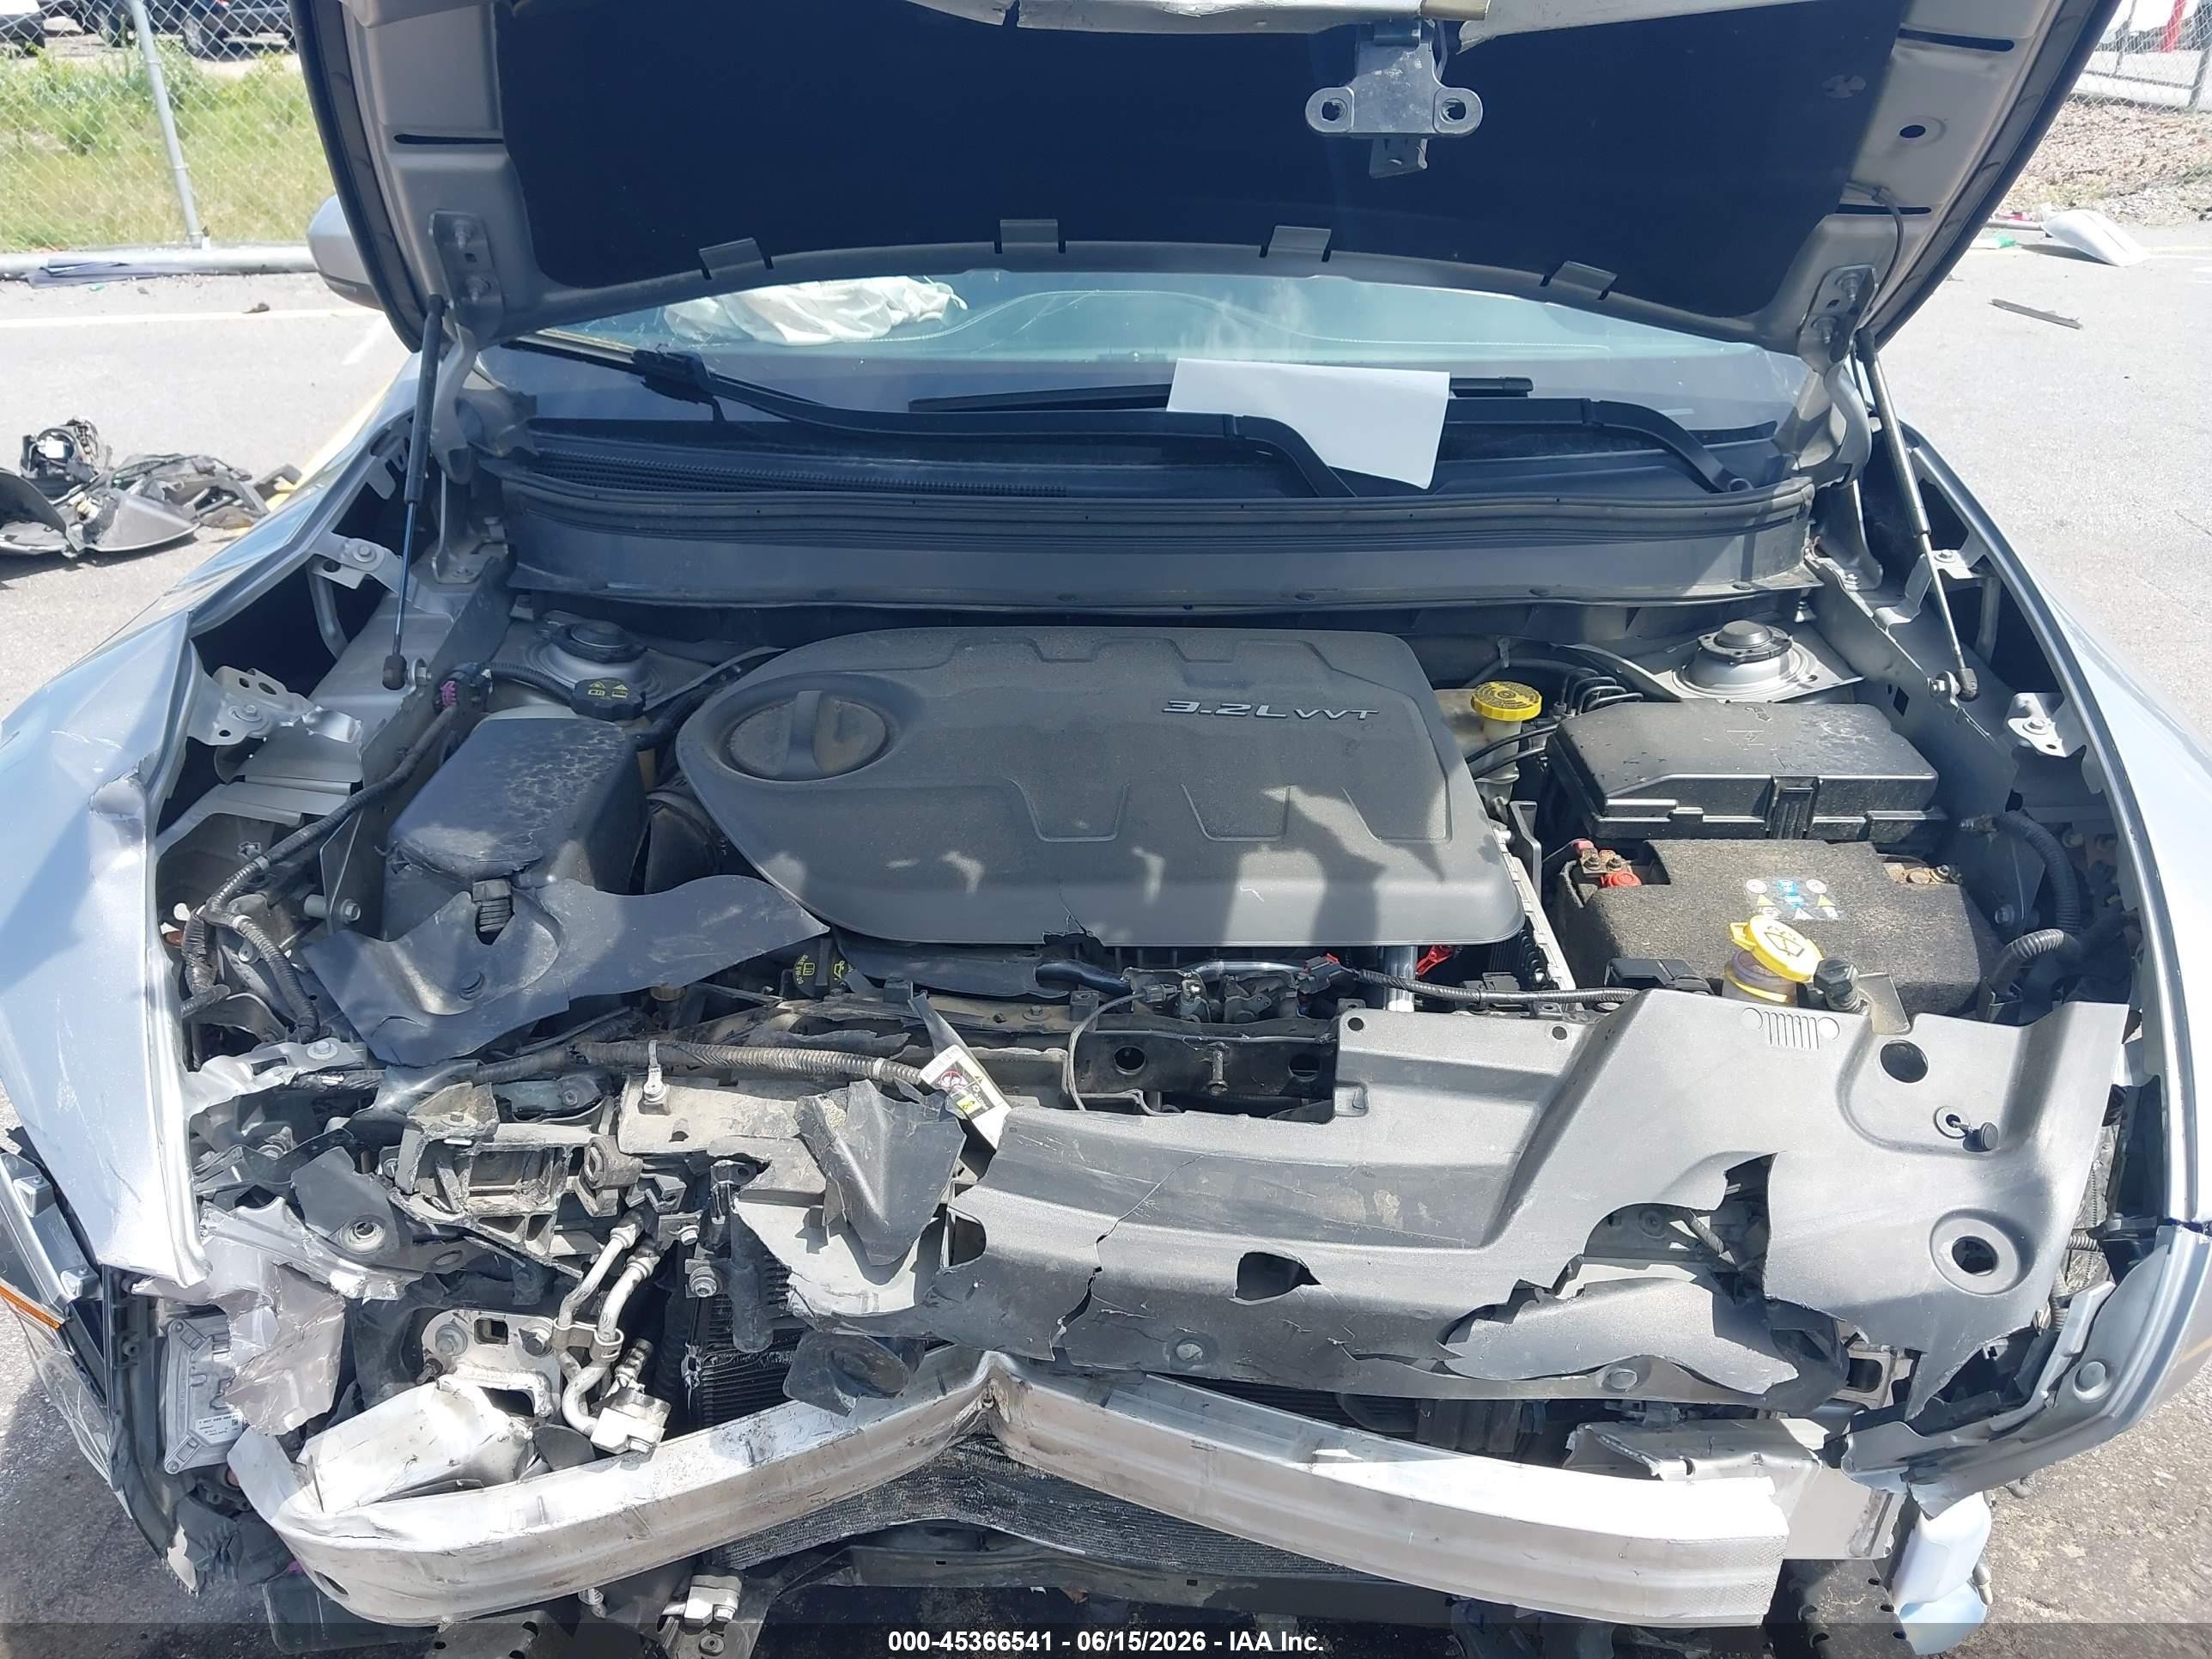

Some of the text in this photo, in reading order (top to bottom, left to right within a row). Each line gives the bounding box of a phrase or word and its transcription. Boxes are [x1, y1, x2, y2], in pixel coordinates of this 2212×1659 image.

[1162, 700, 1379, 720] 3.2L VVT
[795, 966, 804, 985] 5W-20
